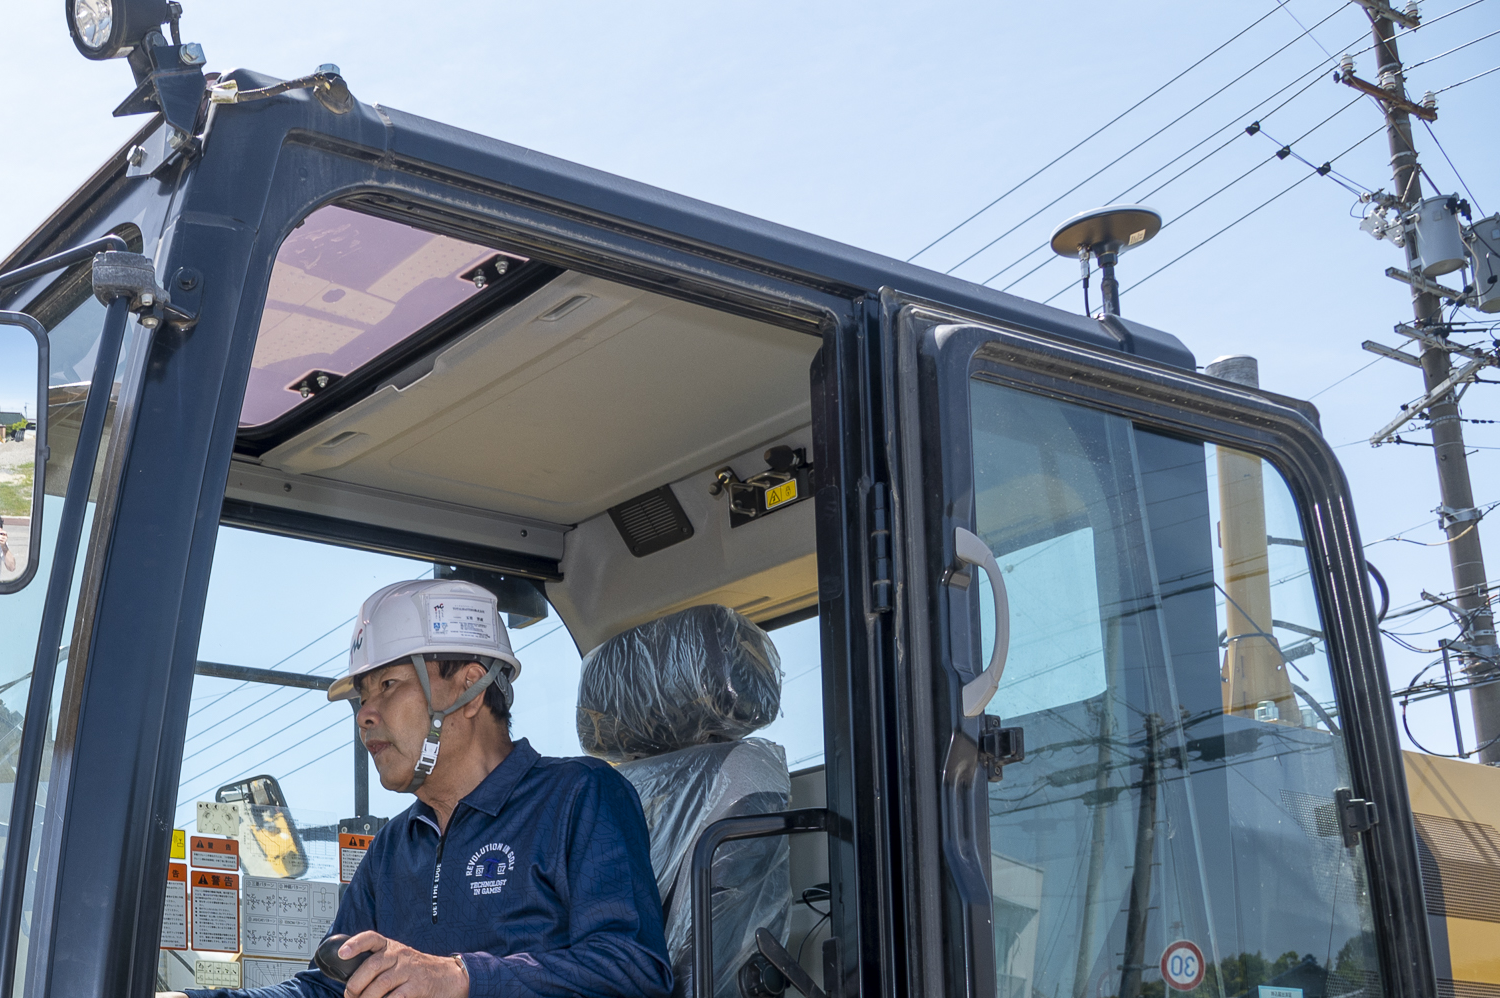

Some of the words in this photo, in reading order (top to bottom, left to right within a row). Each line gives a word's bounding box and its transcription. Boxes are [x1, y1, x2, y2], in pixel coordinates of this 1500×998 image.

[466, 843, 503, 876] REVOLUTION
[507, 852, 515, 871] GOLF
[211, 875, 234, 887] 警告
[470, 879, 507, 889] TECHNOLOGY
[481, 887, 502, 895] GAMES
